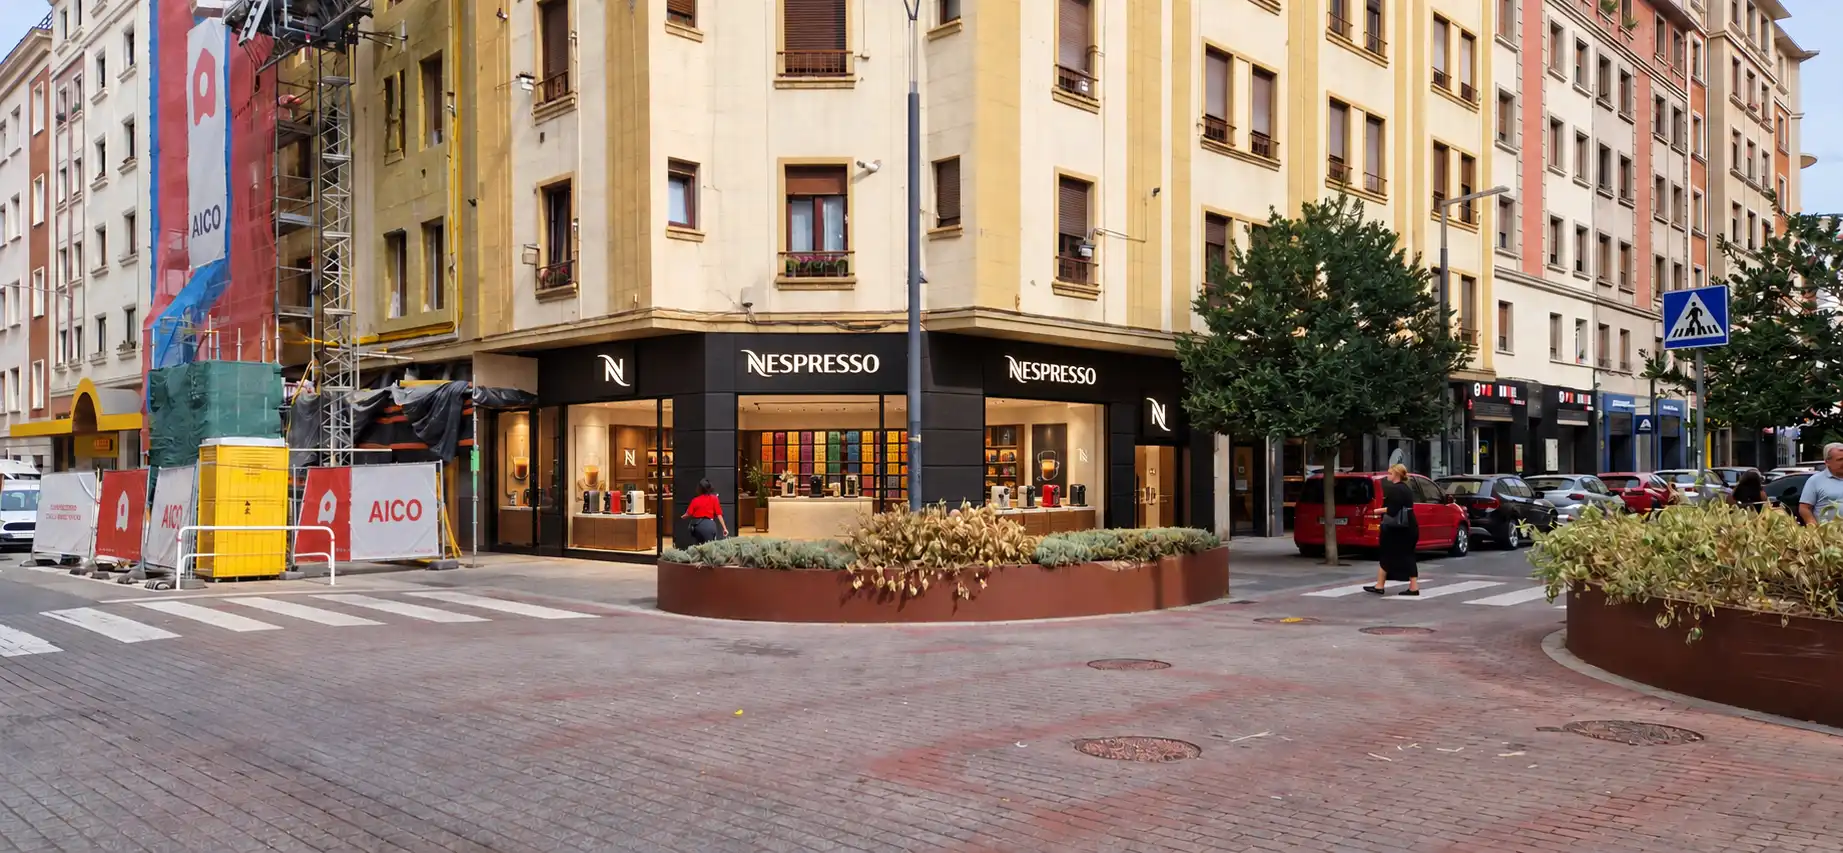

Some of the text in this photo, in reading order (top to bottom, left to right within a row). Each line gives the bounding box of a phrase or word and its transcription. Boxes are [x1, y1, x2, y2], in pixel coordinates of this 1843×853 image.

[192, 205, 221, 238] AICO
[598, 354, 631, 386] N
[741, 349, 880, 377] NESPRESSO
[1005, 355, 1097, 385] NESPRESSO
[1147, 397, 1171, 431] N
[368, 499, 423, 523] AICO
